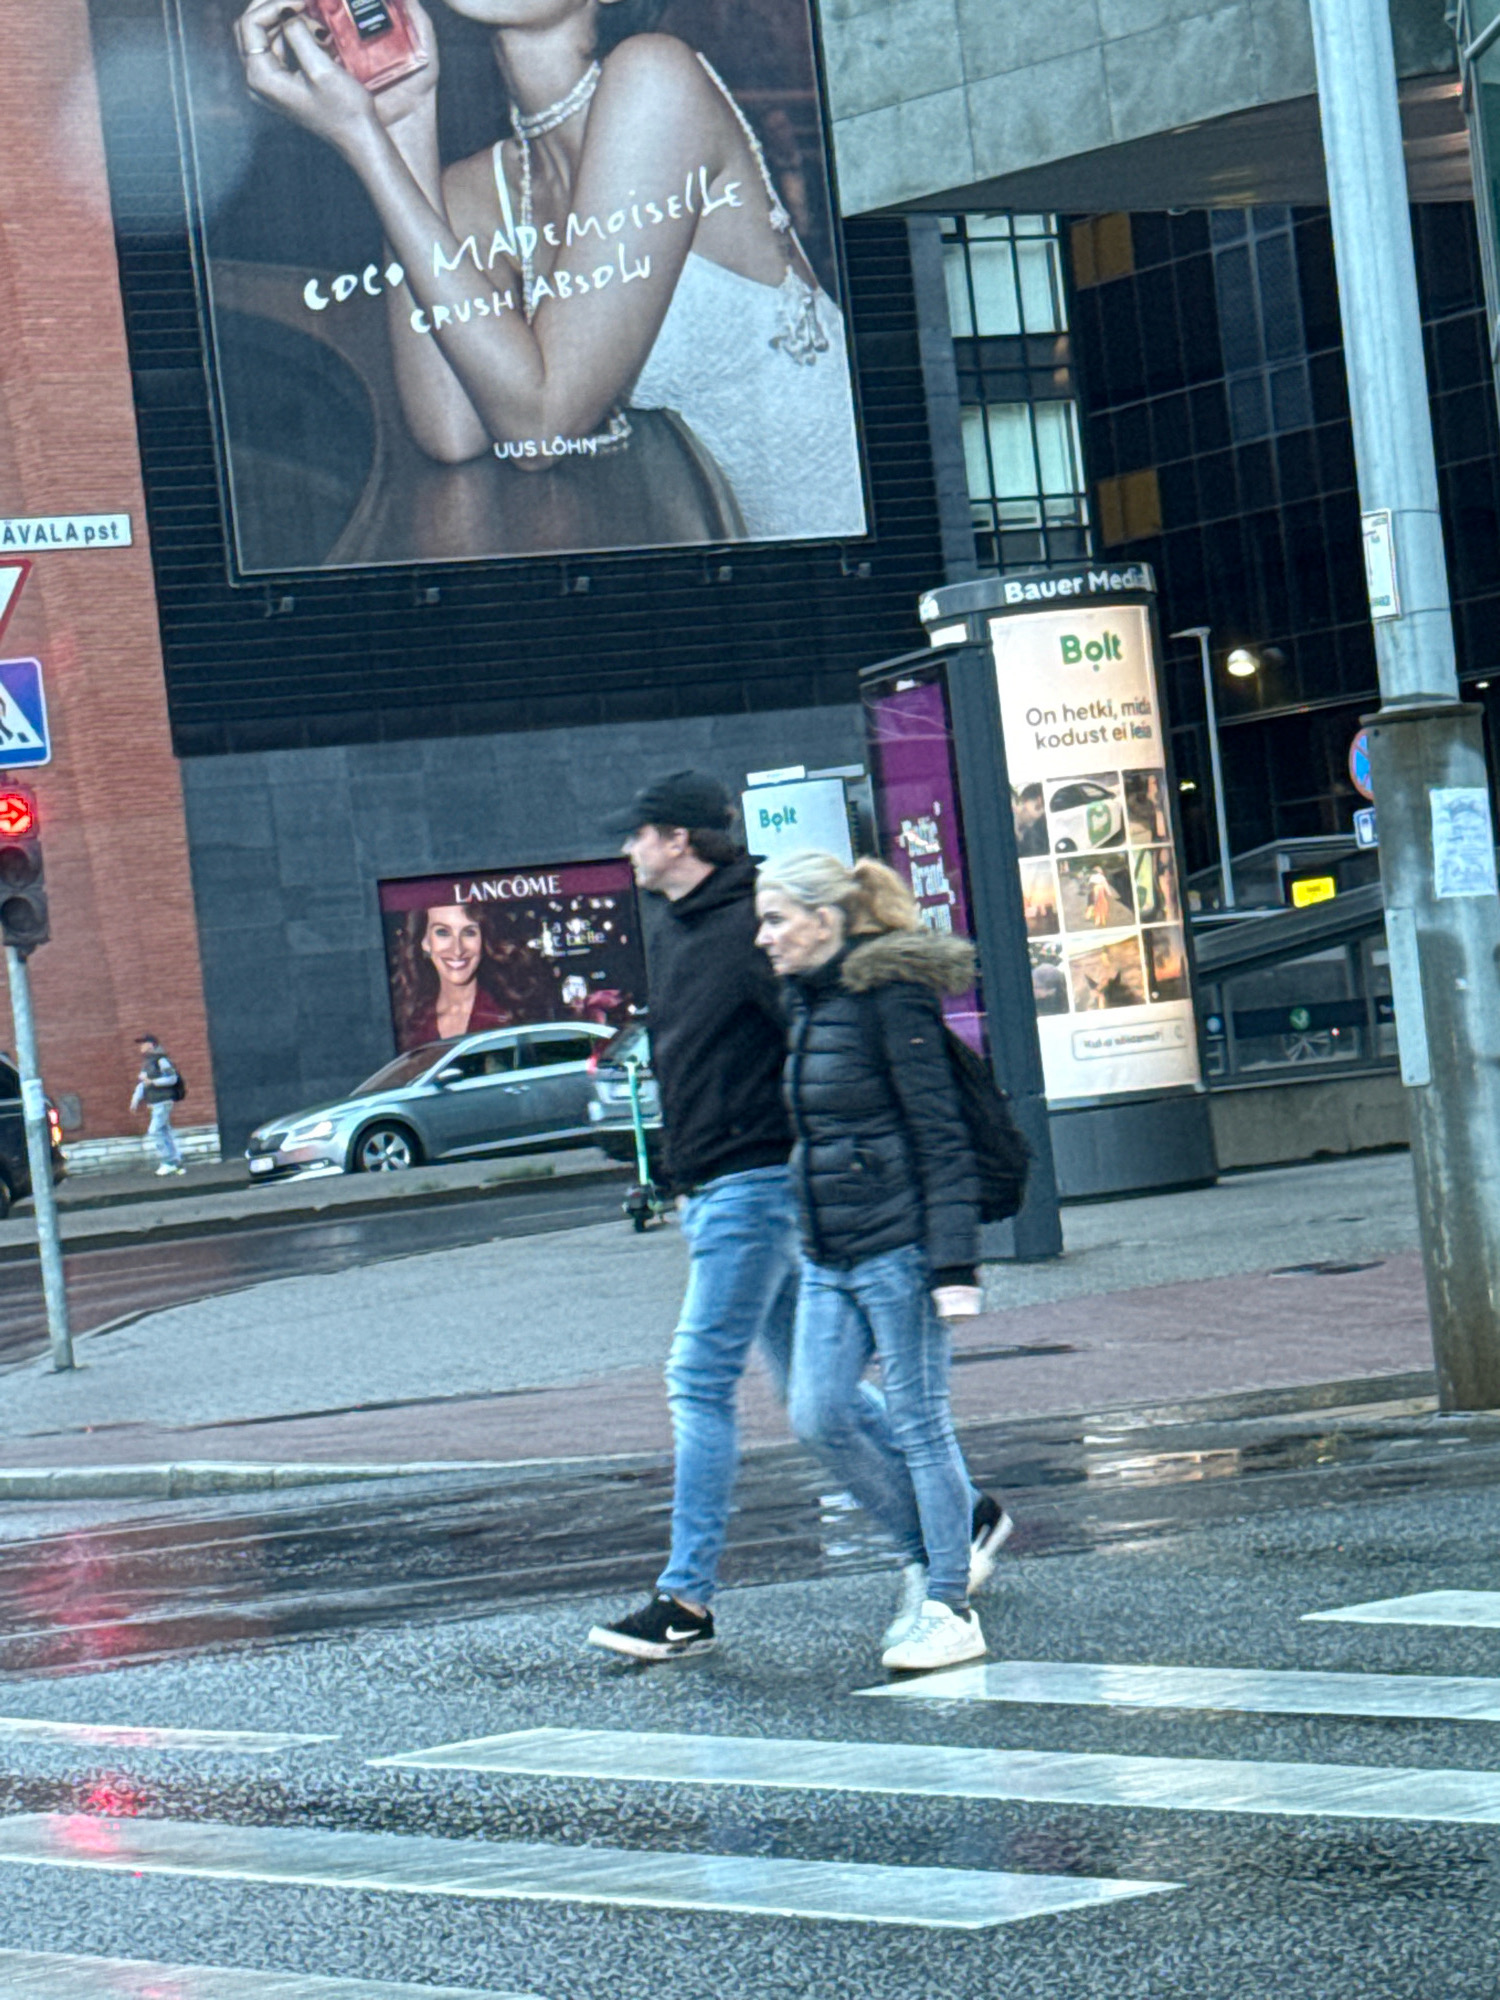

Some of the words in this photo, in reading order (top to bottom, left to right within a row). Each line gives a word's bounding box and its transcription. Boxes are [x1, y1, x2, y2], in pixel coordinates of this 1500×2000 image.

[303, 262, 404, 311] COCO
[410, 290, 514, 335] CRUSH
[493, 440, 538, 459] UUS
[83, 521, 119, 545] pst
[1003, 577, 1083, 604] Bauer
[1060, 631, 1123, 672] Bolt
[1026, 707, 1057, 726] On
[1062, 699, 1118, 722] hetki,
[1035, 725, 1107, 750] kodust
[1112, 722, 1128, 742] ei
[759, 806, 798, 833] Bolt
[454, 875, 562, 903] LANCÔME
[566, 919, 591, 933] ve
